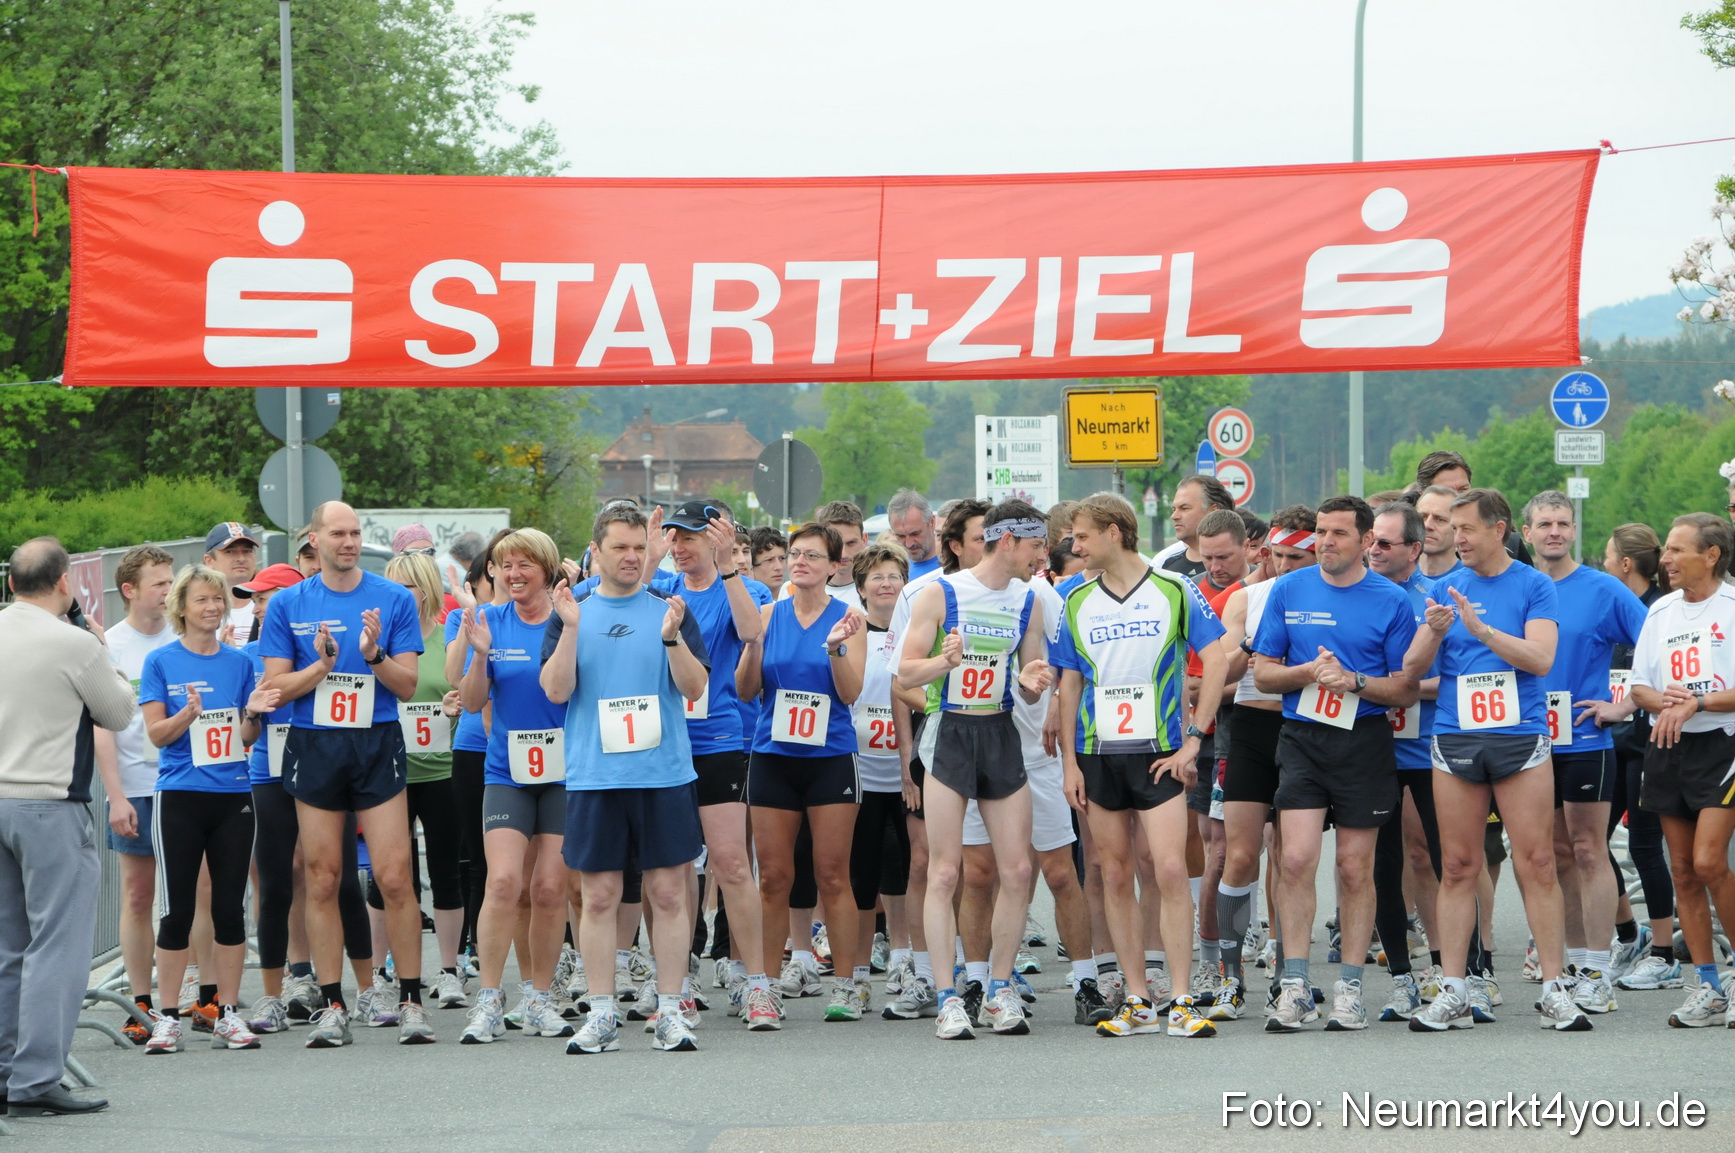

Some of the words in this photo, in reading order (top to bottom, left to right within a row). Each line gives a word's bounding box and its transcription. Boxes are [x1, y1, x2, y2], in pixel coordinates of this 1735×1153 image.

[1101, 403, 1126, 412] Nach
[1077, 417, 1150, 435] Neumarkt
[1219, 422, 1243, 444] 60
[1102, 441, 1107, 450] 5
[1115, 441, 1128, 450] km
[1564, 435, 1595, 443] Landwirt-
[1561, 444, 1599, 452] schaftlicher
[994, 468, 1011, 486] SHB
[964, 624, 1016, 639] BOCK
[1090, 620, 1161, 645] BOCK
[1667, 633, 1690, 645] MEYER
[961, 653, 988, 662] MEYER
[1670, 646, 1701, 681] 86
[326, 674, 353, 683] MEYER
[961, 668, 995, 699] 92
[1466, 675, 1493, 684] MEYER
[784, 692, 810, 701] MEYER
[1105, 687, 1132, 696] MEYER
[330, 691, 358, 722] 61
[608, 699, 636, 708] MEYER
[784, 698, 809, 706] WERBUNG
[1314, 685, 1344, 719] 16
[1470, 689, 1507, 723] 66
[200, 712, 225, 721] MEYER
[788, 706, 816, 738] 10
[1117, 702, 1134, 734] 2
[416, 717, 431, 746] 5
[517, 732, 543, 740] MEYER
[622, 713, 636, 744] 1
[868, 719, 899, 750] 25
[206, 726, 233, 759] 67
[528, 746, 544, 778] 9
[485, 813, 510, 823] ODLO
